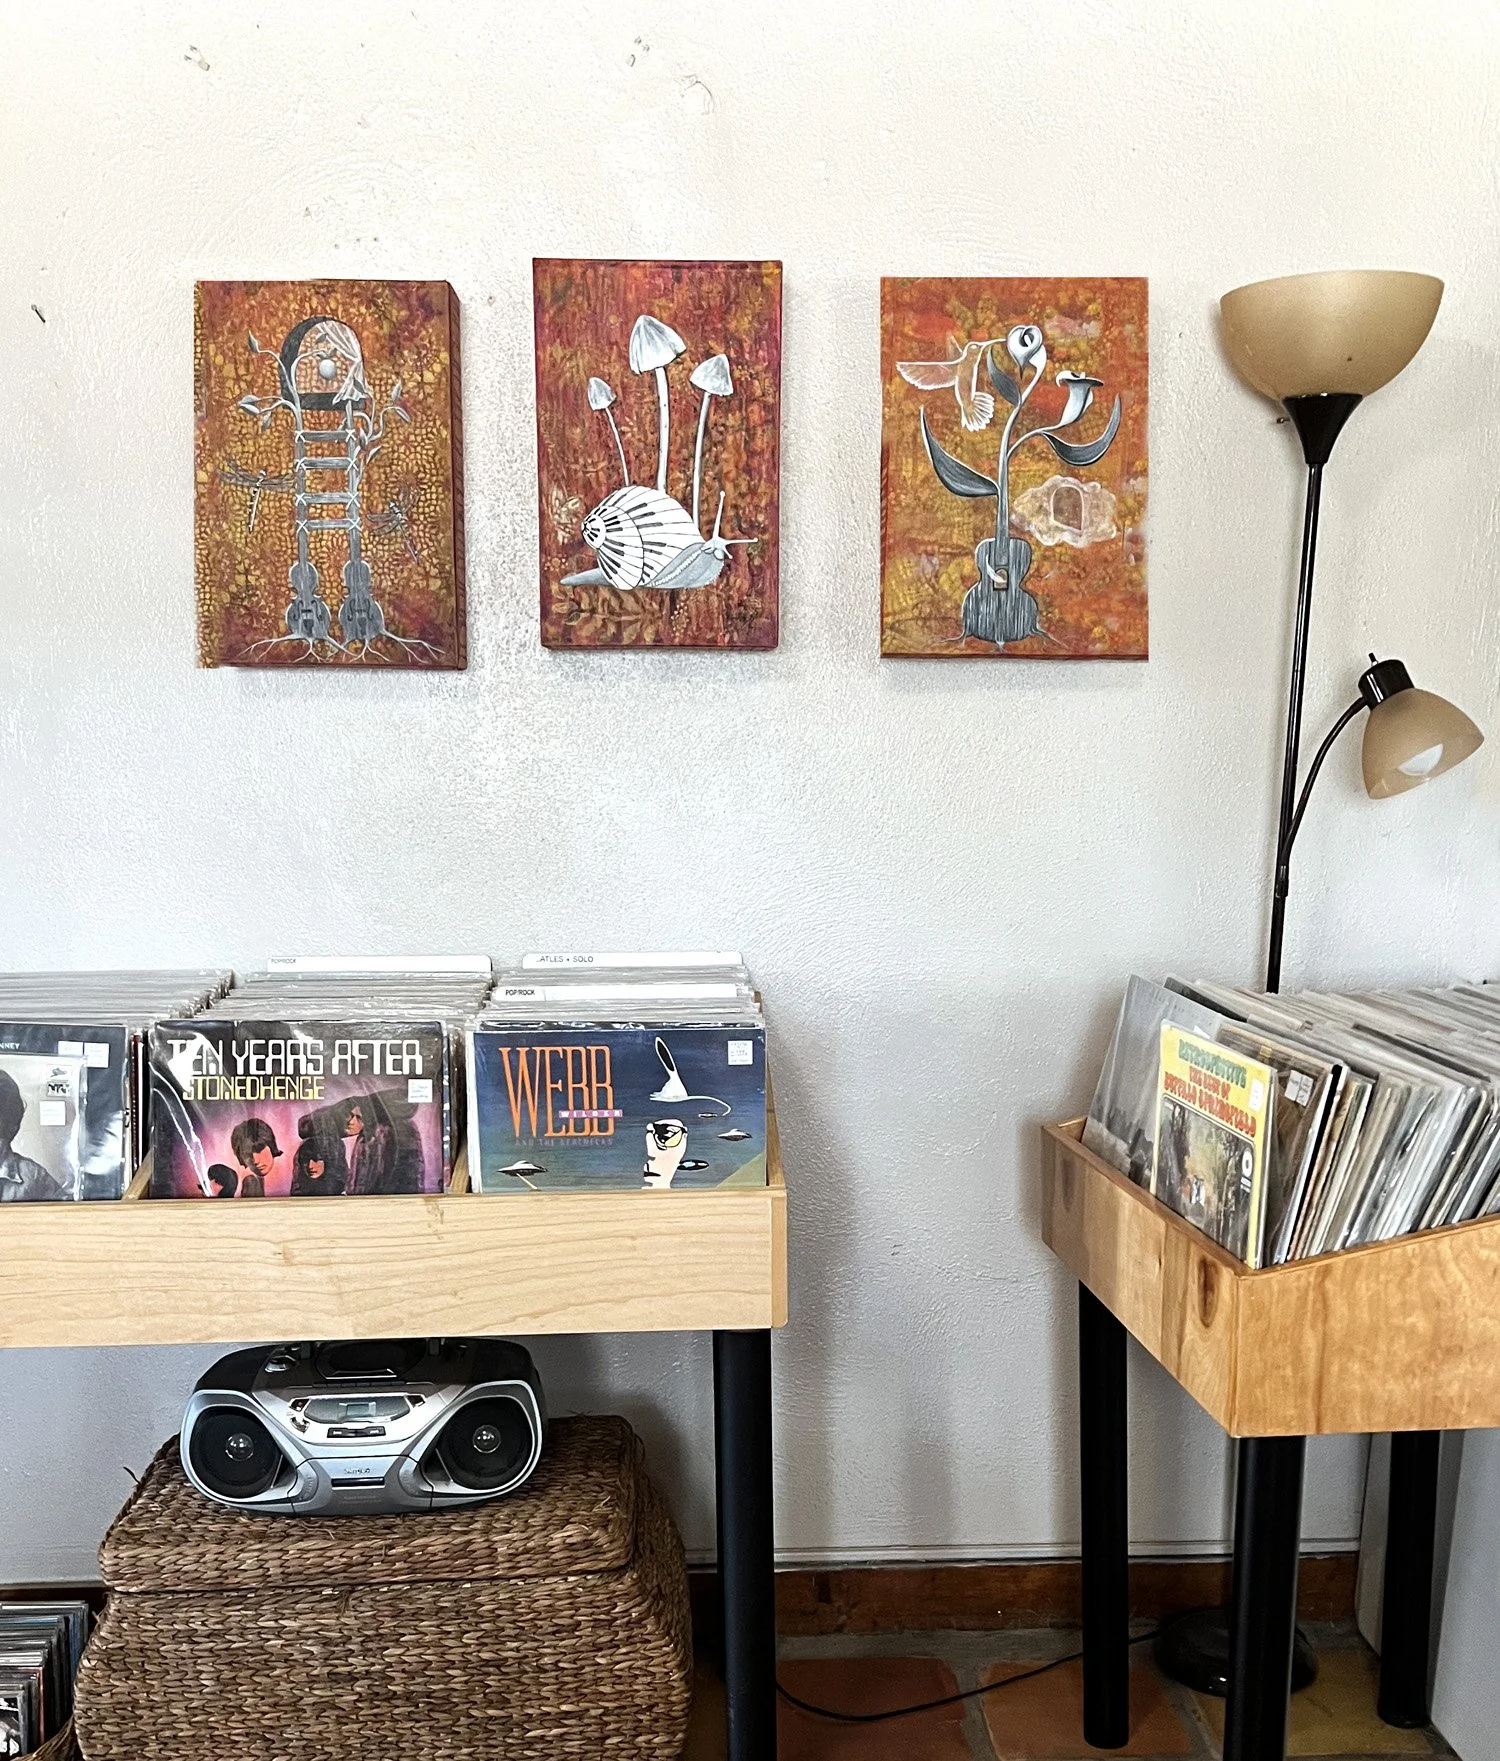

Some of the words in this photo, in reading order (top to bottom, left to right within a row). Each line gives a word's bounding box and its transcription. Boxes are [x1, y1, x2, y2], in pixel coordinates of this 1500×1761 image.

[535, 955, 563, 963] ATLES
[573, 955, 594, 963] SOLO
[231, 1039, 324, 1075] YEARS
[331, 1039, 423, 1075] AFTER
[182, 1075, 325, 1101] STONEDHENGE
[498, 1045, 615, 1138] WEBB
